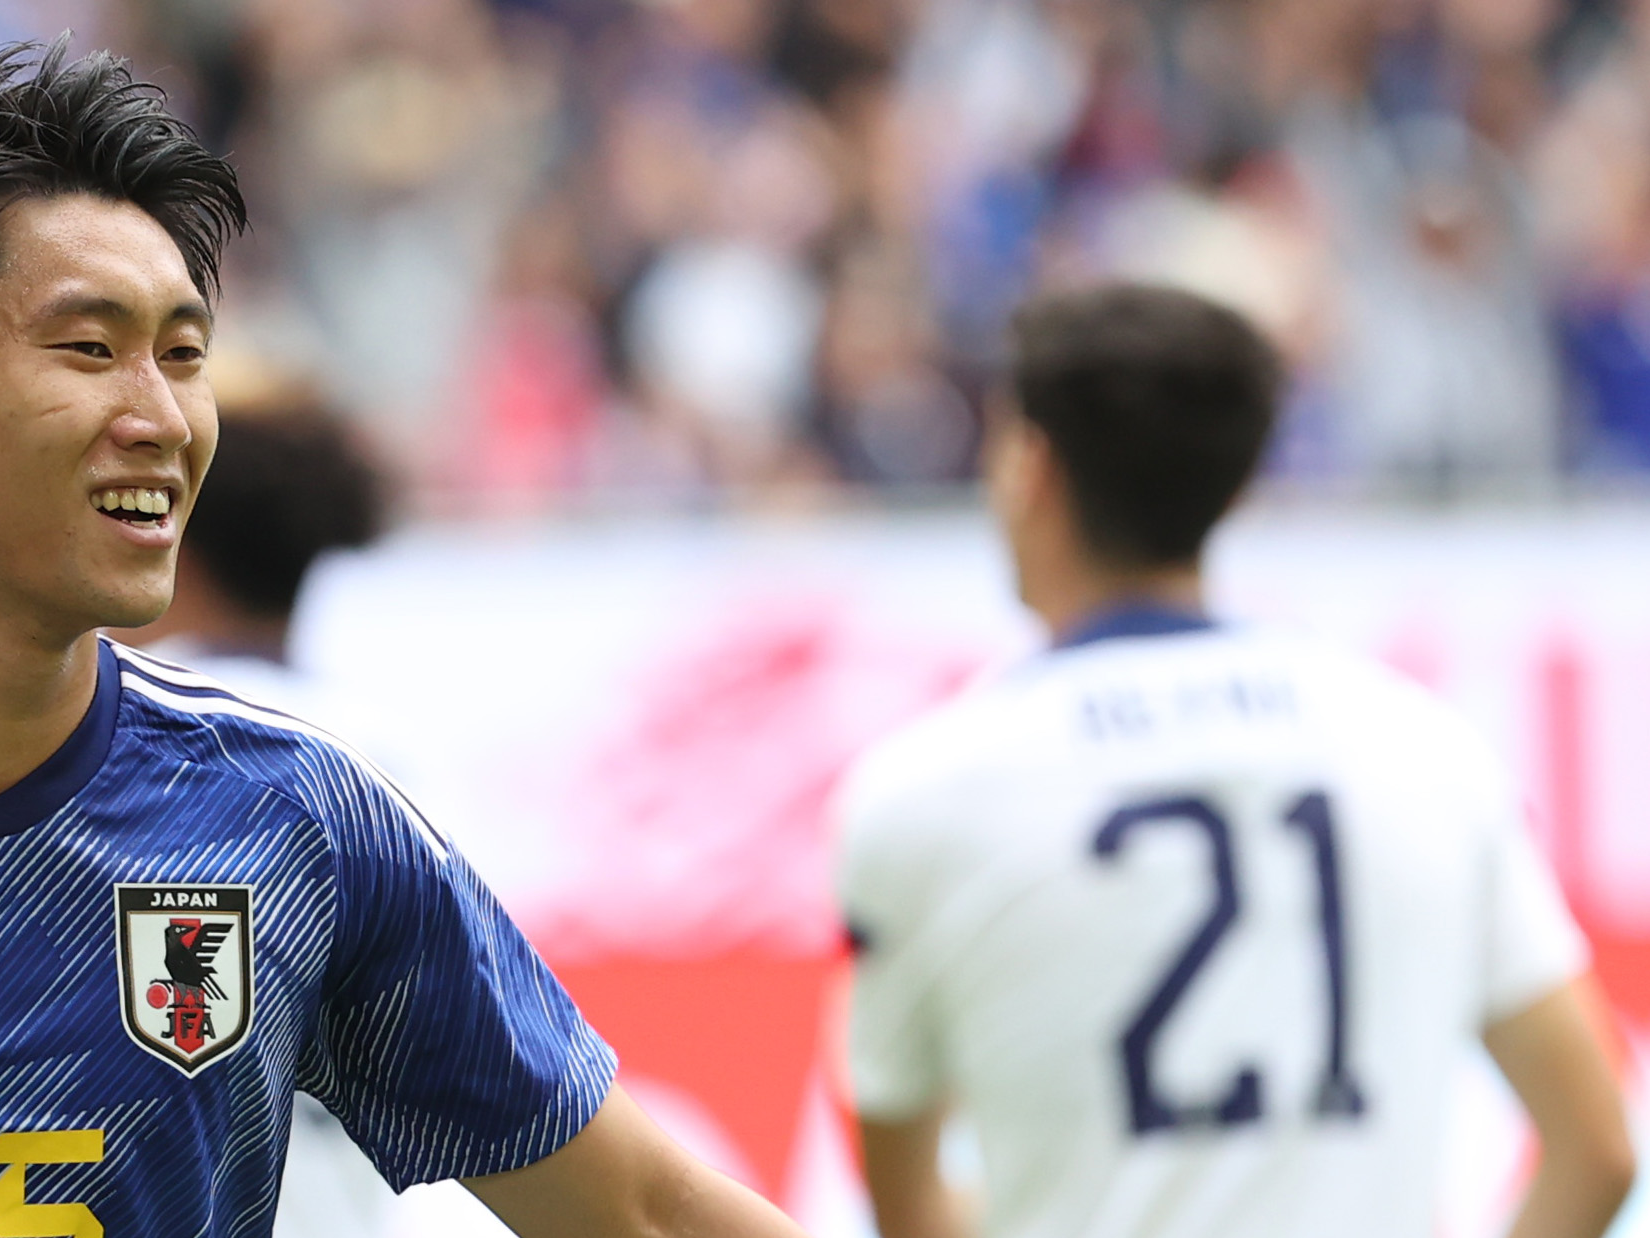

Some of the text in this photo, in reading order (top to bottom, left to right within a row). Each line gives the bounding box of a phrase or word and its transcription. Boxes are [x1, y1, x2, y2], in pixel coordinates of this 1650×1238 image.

[150, 892, 218, 907] JAPAN
[1088, 788, 1368, 1138] 21
[160, 1012, 217, 1040] JFA
